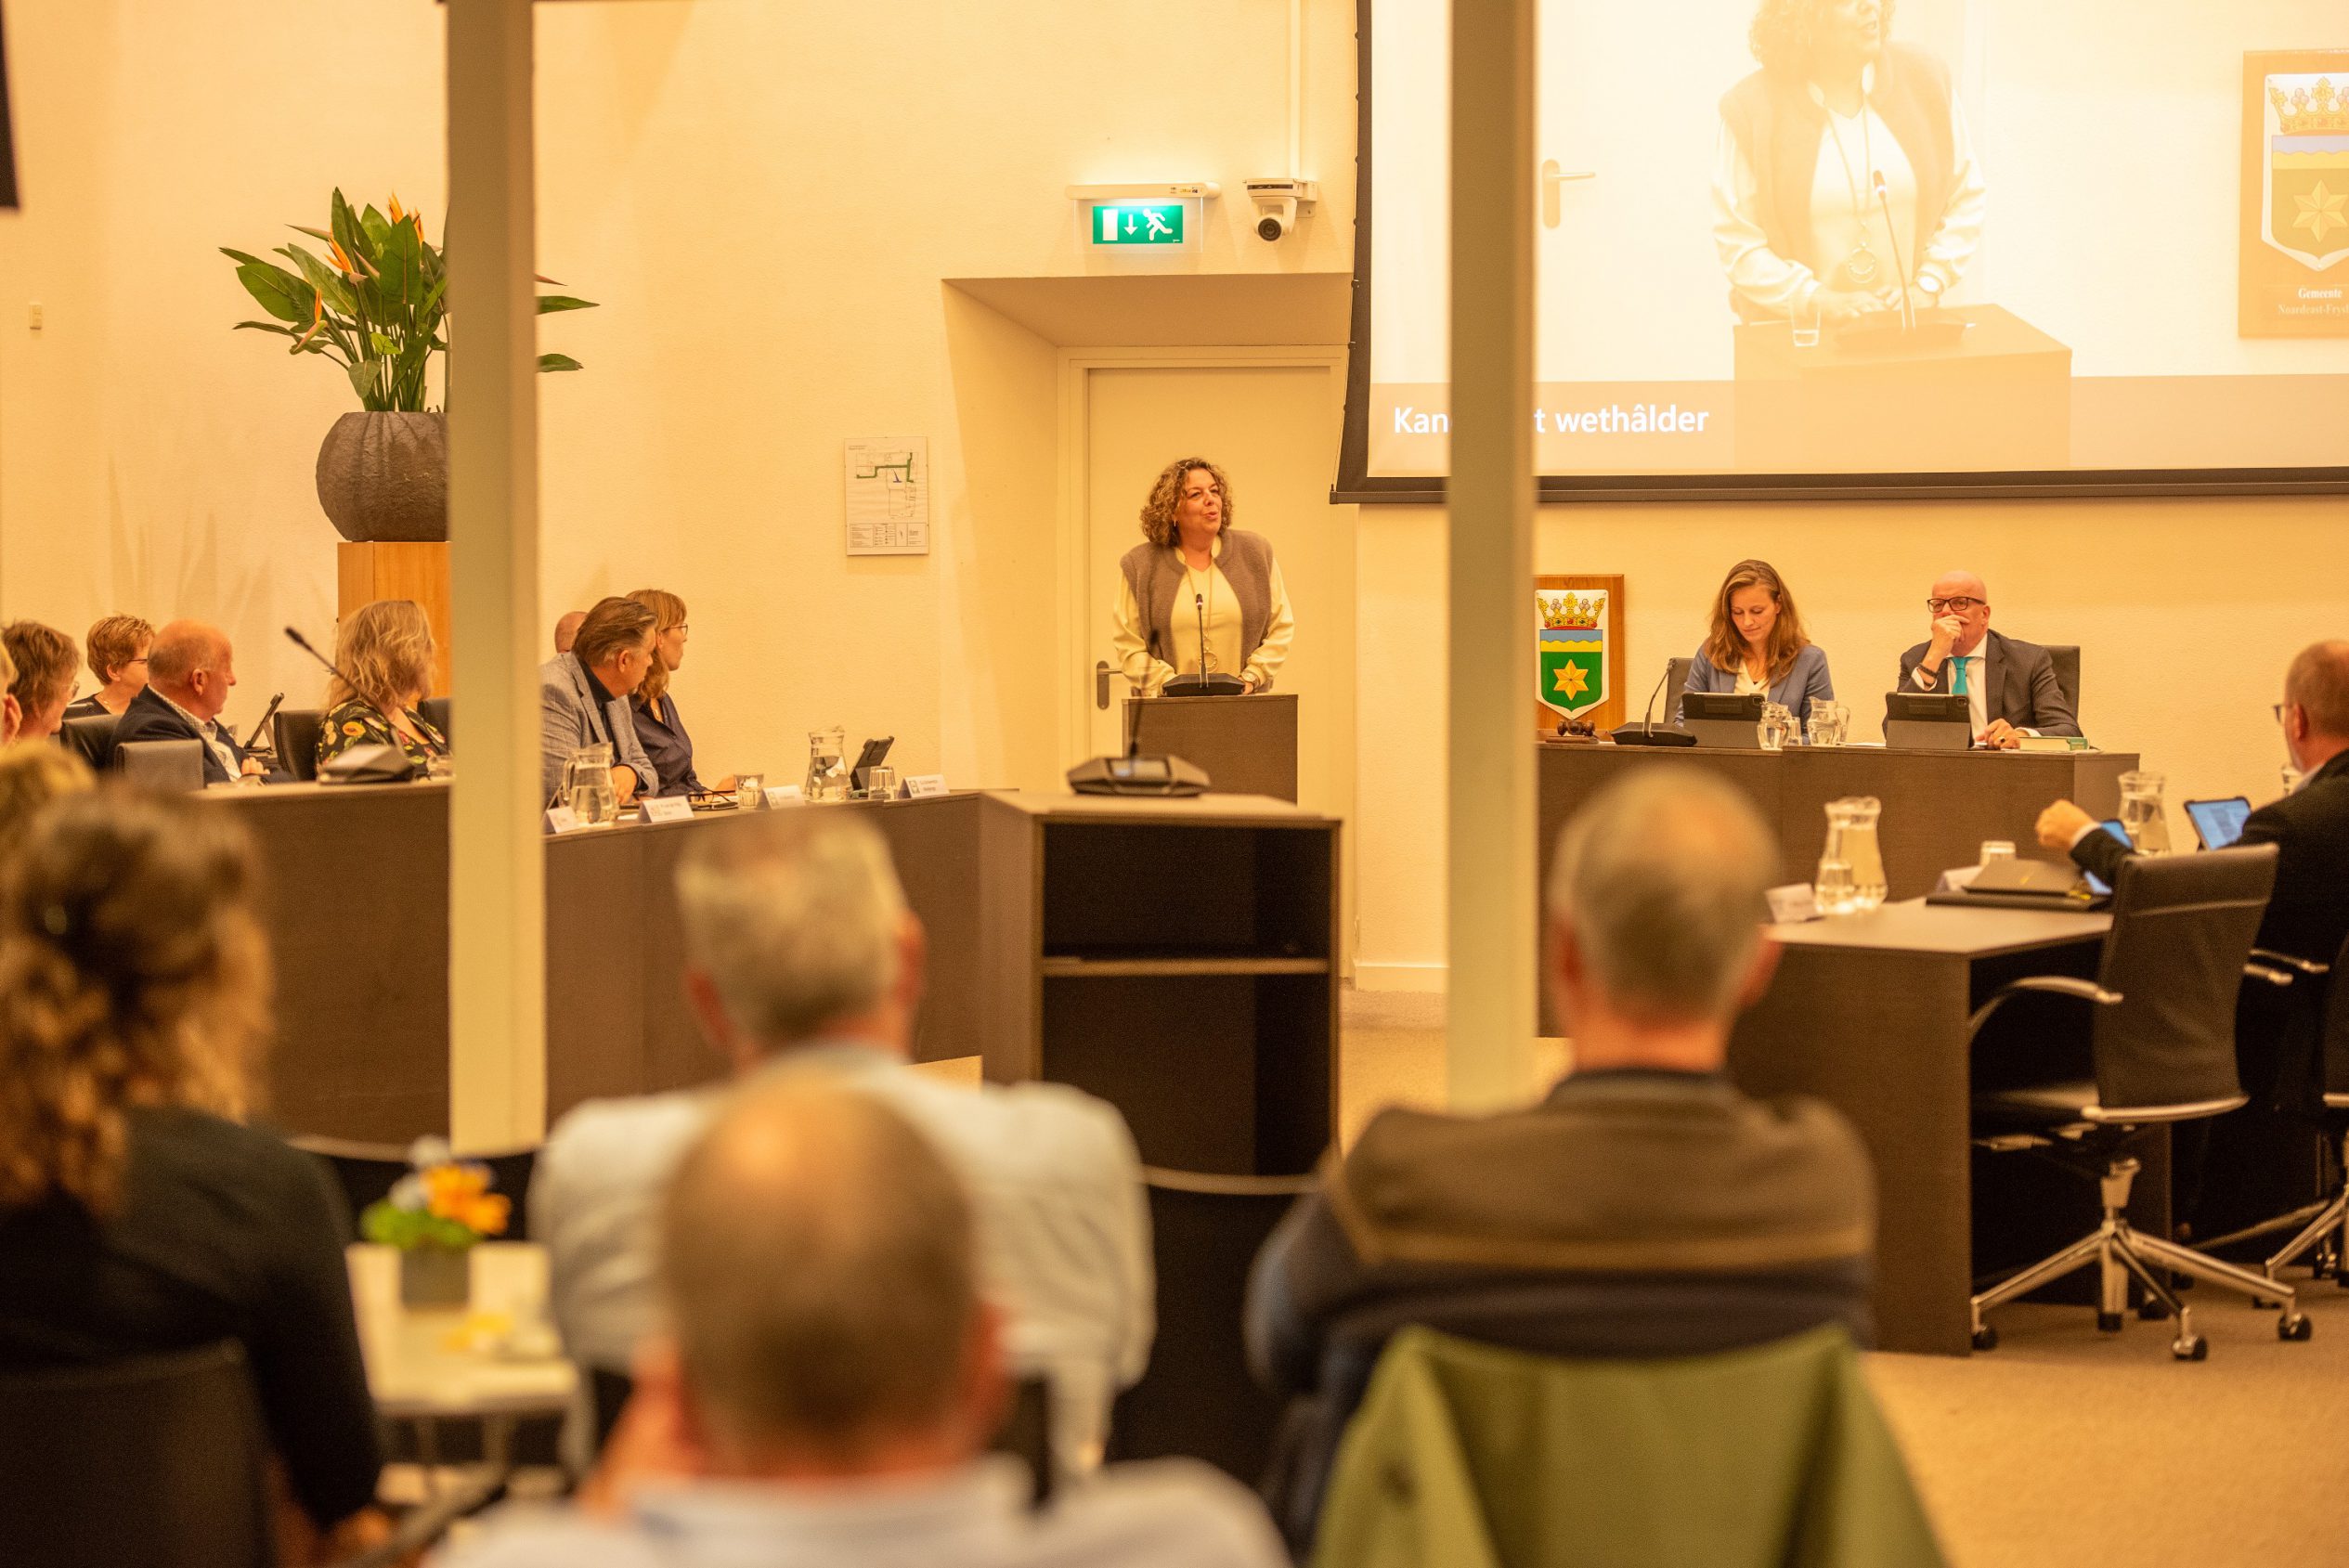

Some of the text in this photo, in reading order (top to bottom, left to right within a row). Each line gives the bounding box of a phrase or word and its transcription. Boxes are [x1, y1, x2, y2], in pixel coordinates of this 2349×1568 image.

[2298, 287, 2342, 298] Gemeente
[2278, 304, 2349, 316] Noardeast-Frysl
[1556, 404, 1709, 433] wethâlder
